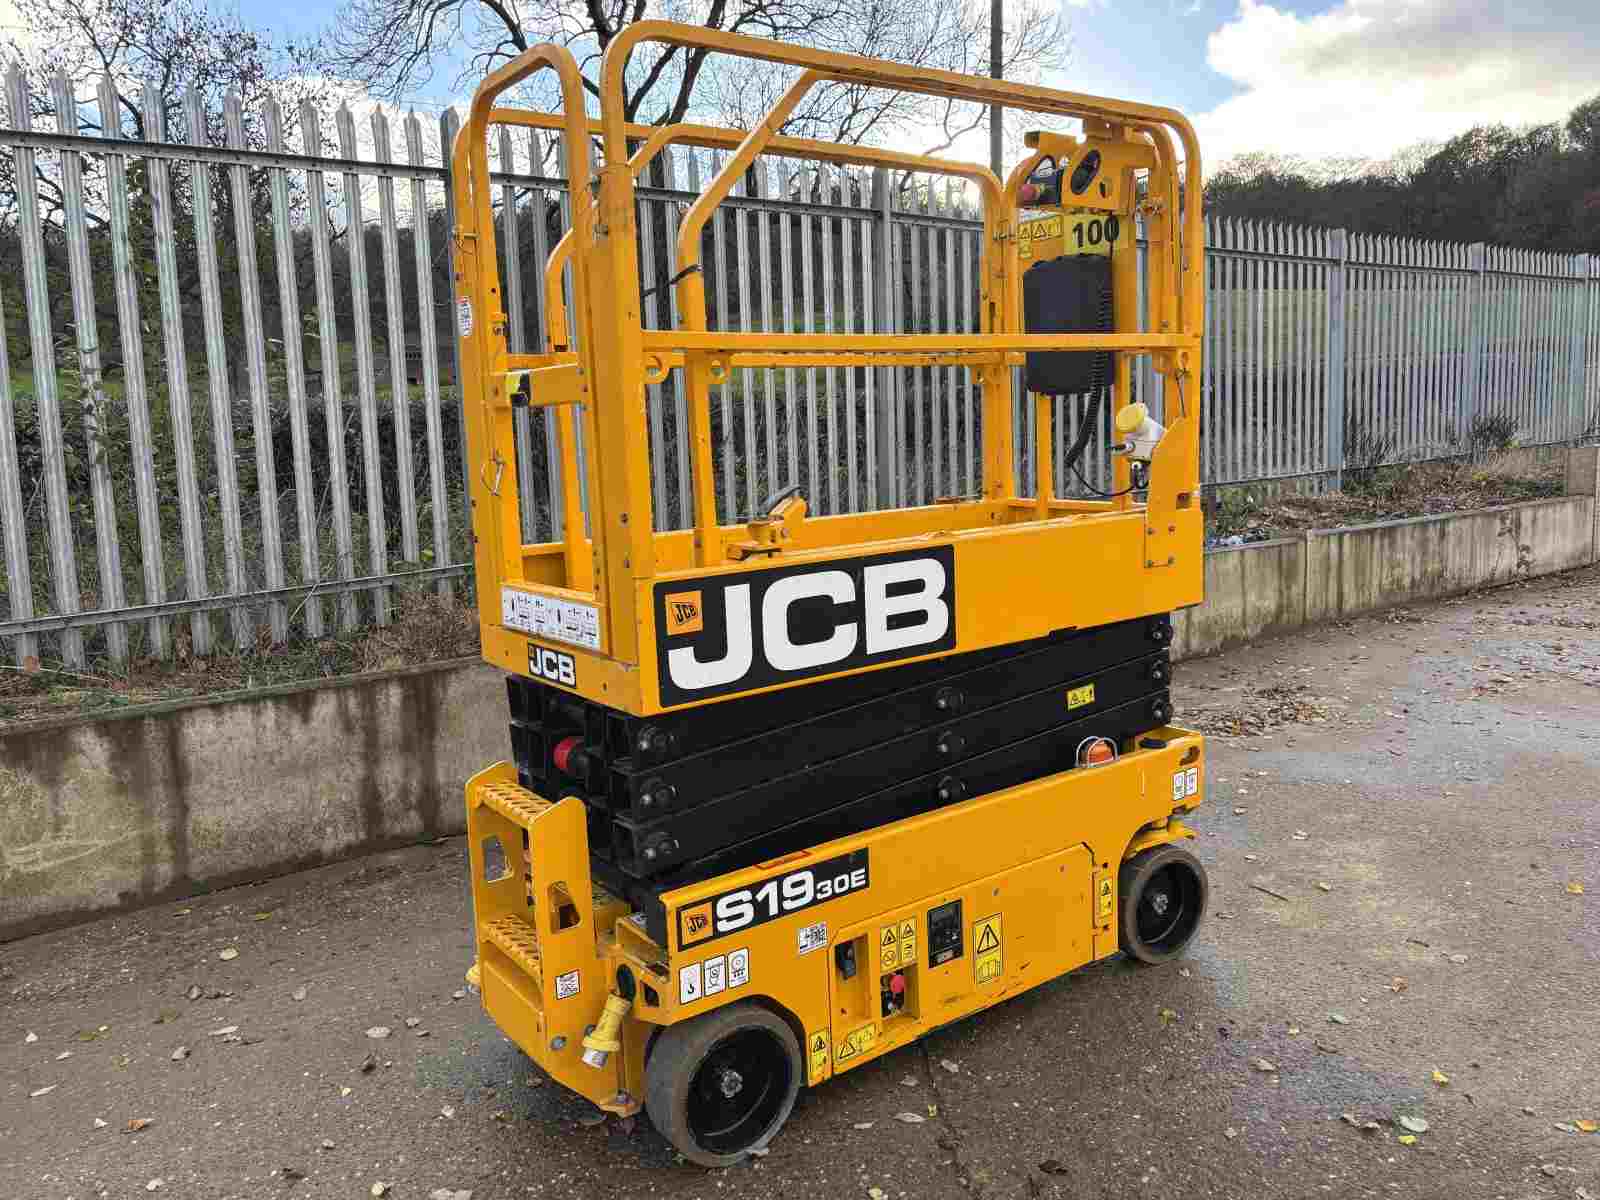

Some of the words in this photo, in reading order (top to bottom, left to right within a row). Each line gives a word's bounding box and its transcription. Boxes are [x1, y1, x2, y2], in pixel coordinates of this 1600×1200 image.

[1072, 215, 1120, 248] 100
[668, 558, 949, 690] JCB
[529, 647, 576, 686] JCB
